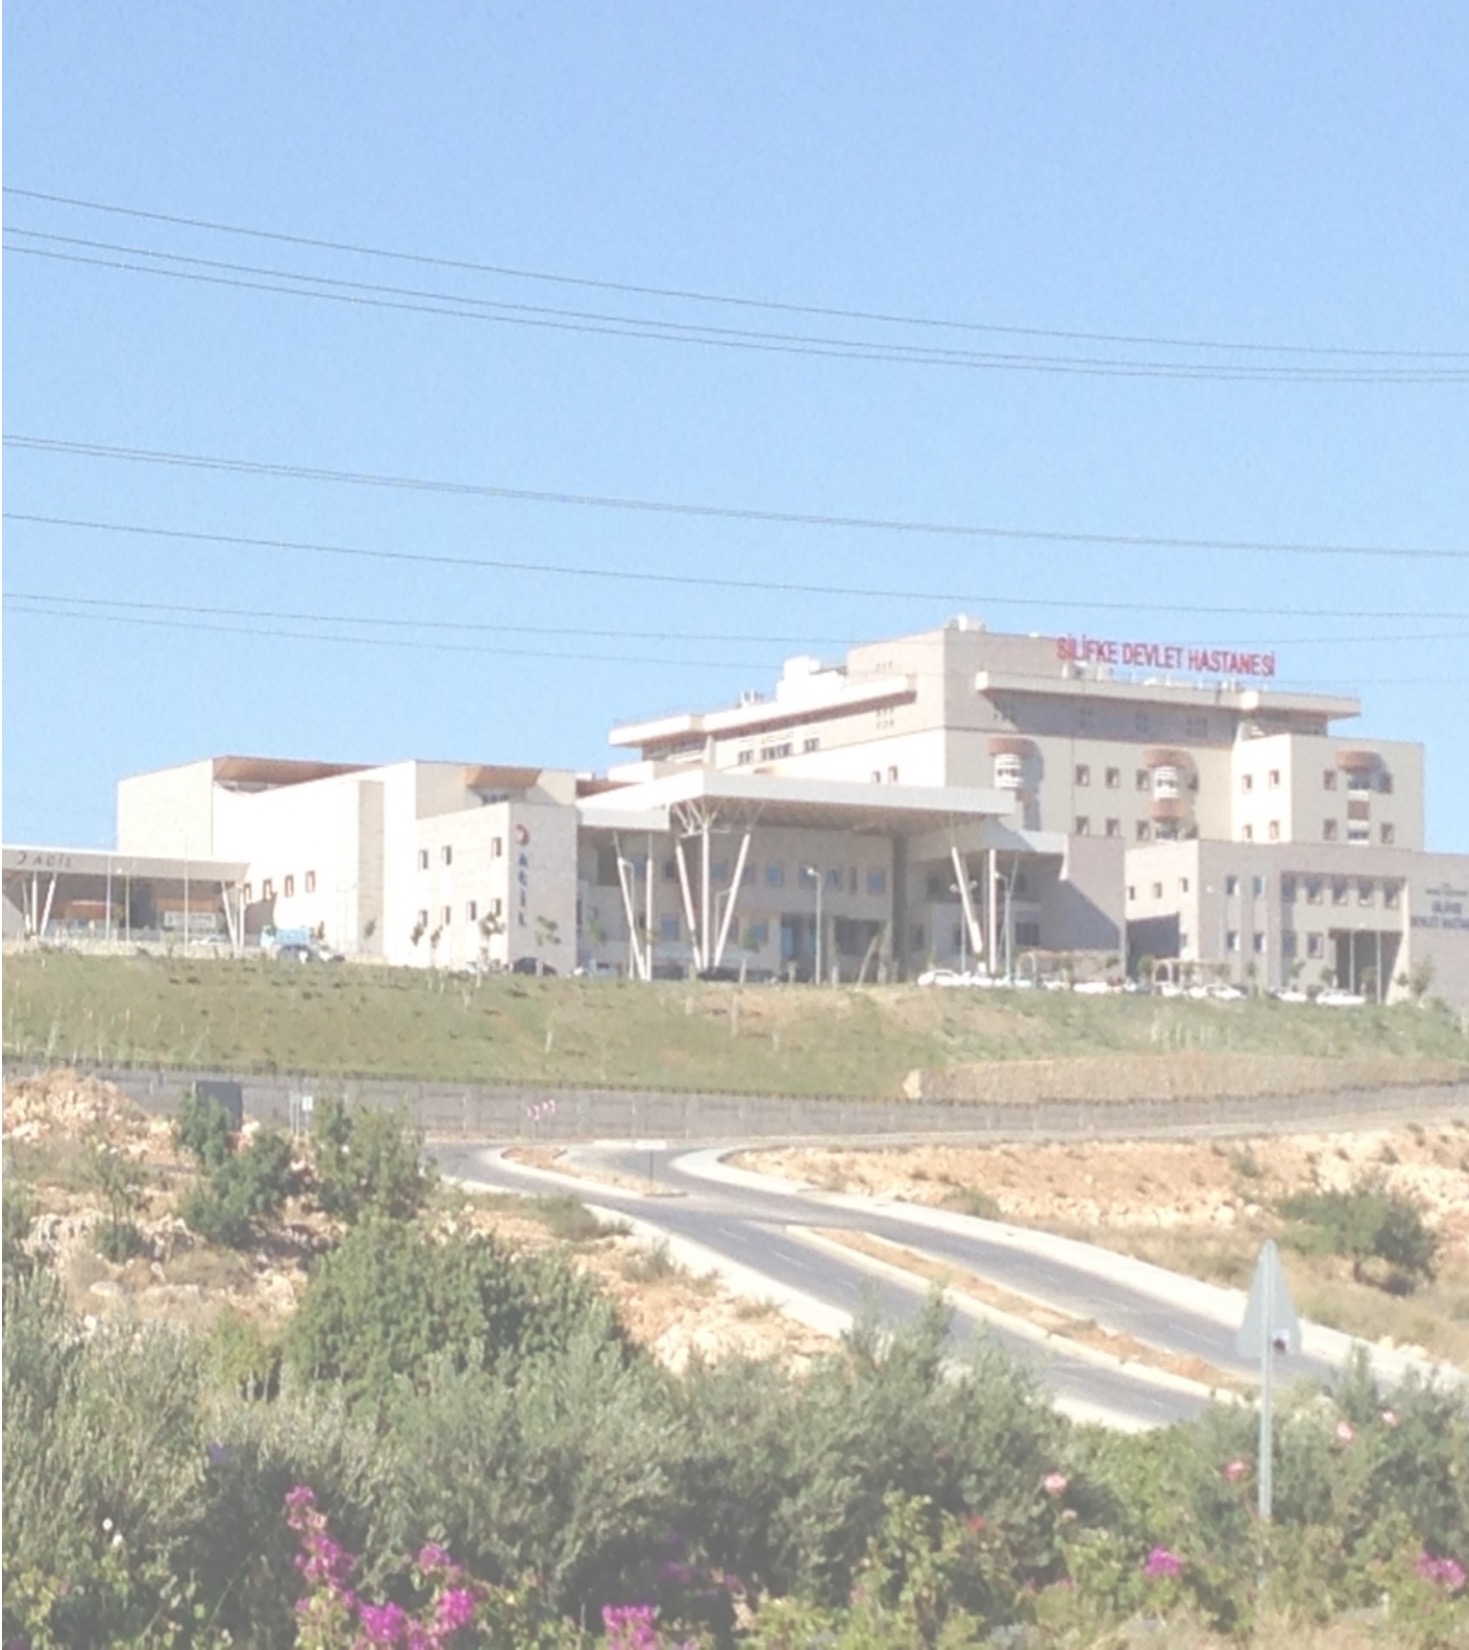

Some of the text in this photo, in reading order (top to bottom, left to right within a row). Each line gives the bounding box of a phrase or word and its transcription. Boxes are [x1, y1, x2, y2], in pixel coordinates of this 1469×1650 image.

[1056, 635, 1275, 677] SİLİFKE DEVLET HASTANESİ
